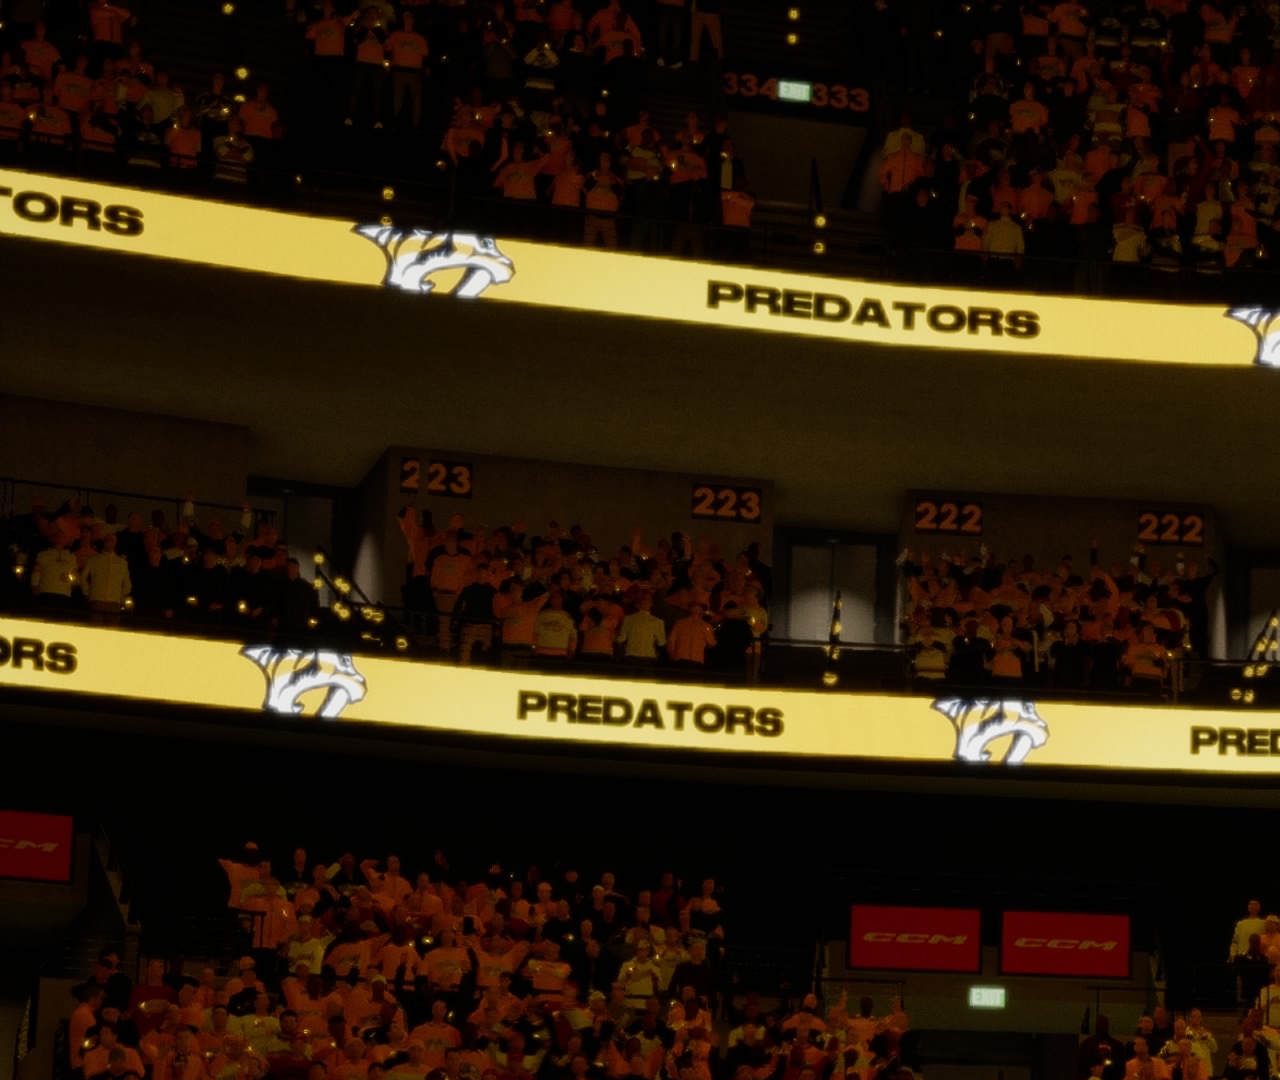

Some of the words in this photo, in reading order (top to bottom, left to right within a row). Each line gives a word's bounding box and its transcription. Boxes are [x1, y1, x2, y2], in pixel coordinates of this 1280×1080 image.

[721, 71, 778, 101] 334
[812, 81, 872, 113] 333
[707, 279, 1041, 340] PREDATORS
[692, 486, 762, 519] 223
[915, 500, 983, 533] 222
[1137, 512, 1204, 544] 222
[517, 689, 785, 738] PREDATORS
[862, 932, 969, 945] CCM
[1013, 937, 1119, 951] CCM
